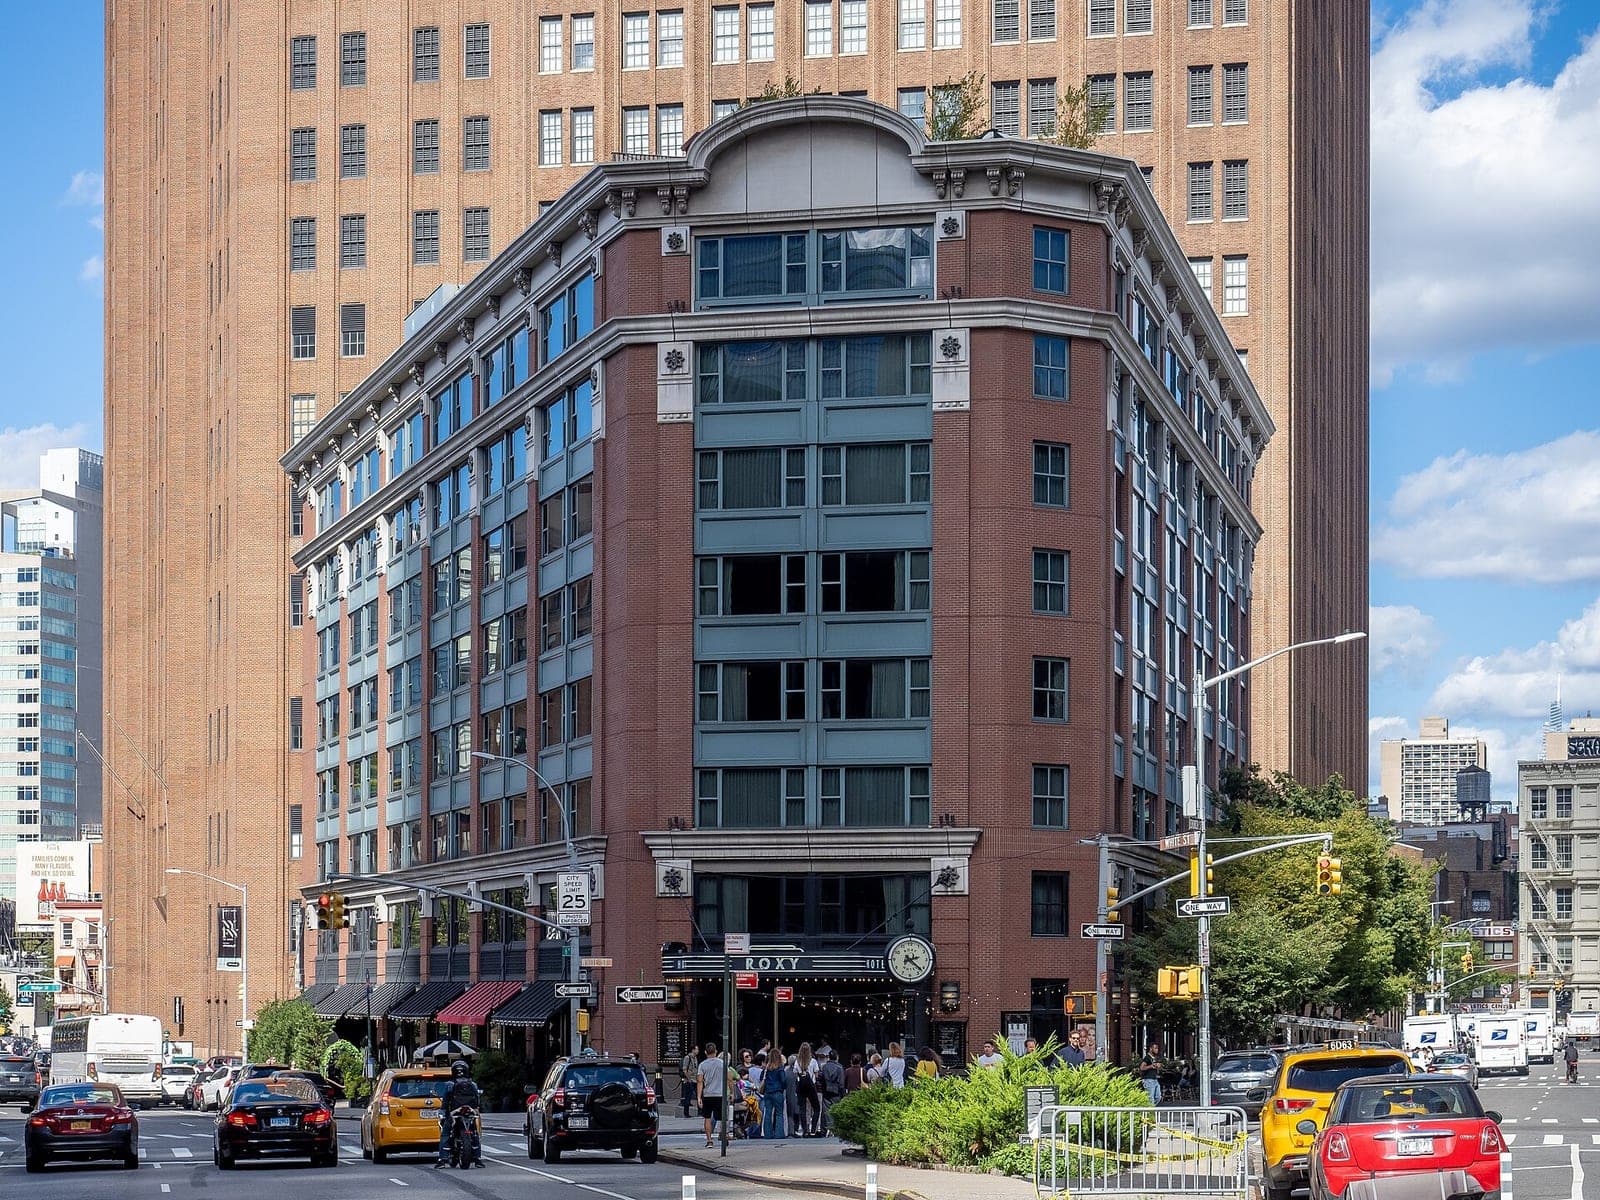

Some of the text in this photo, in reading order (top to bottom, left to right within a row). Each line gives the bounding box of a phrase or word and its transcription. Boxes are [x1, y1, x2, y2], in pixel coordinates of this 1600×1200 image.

[1164, 834, 1190, 848] WHITE ST
[562, 894, 586, 908] 25
[745, 957, 799, 970] ROXY
[623, 991, 639, 999] ONE
[1330, 1040, 1352, 1049] 6D63
